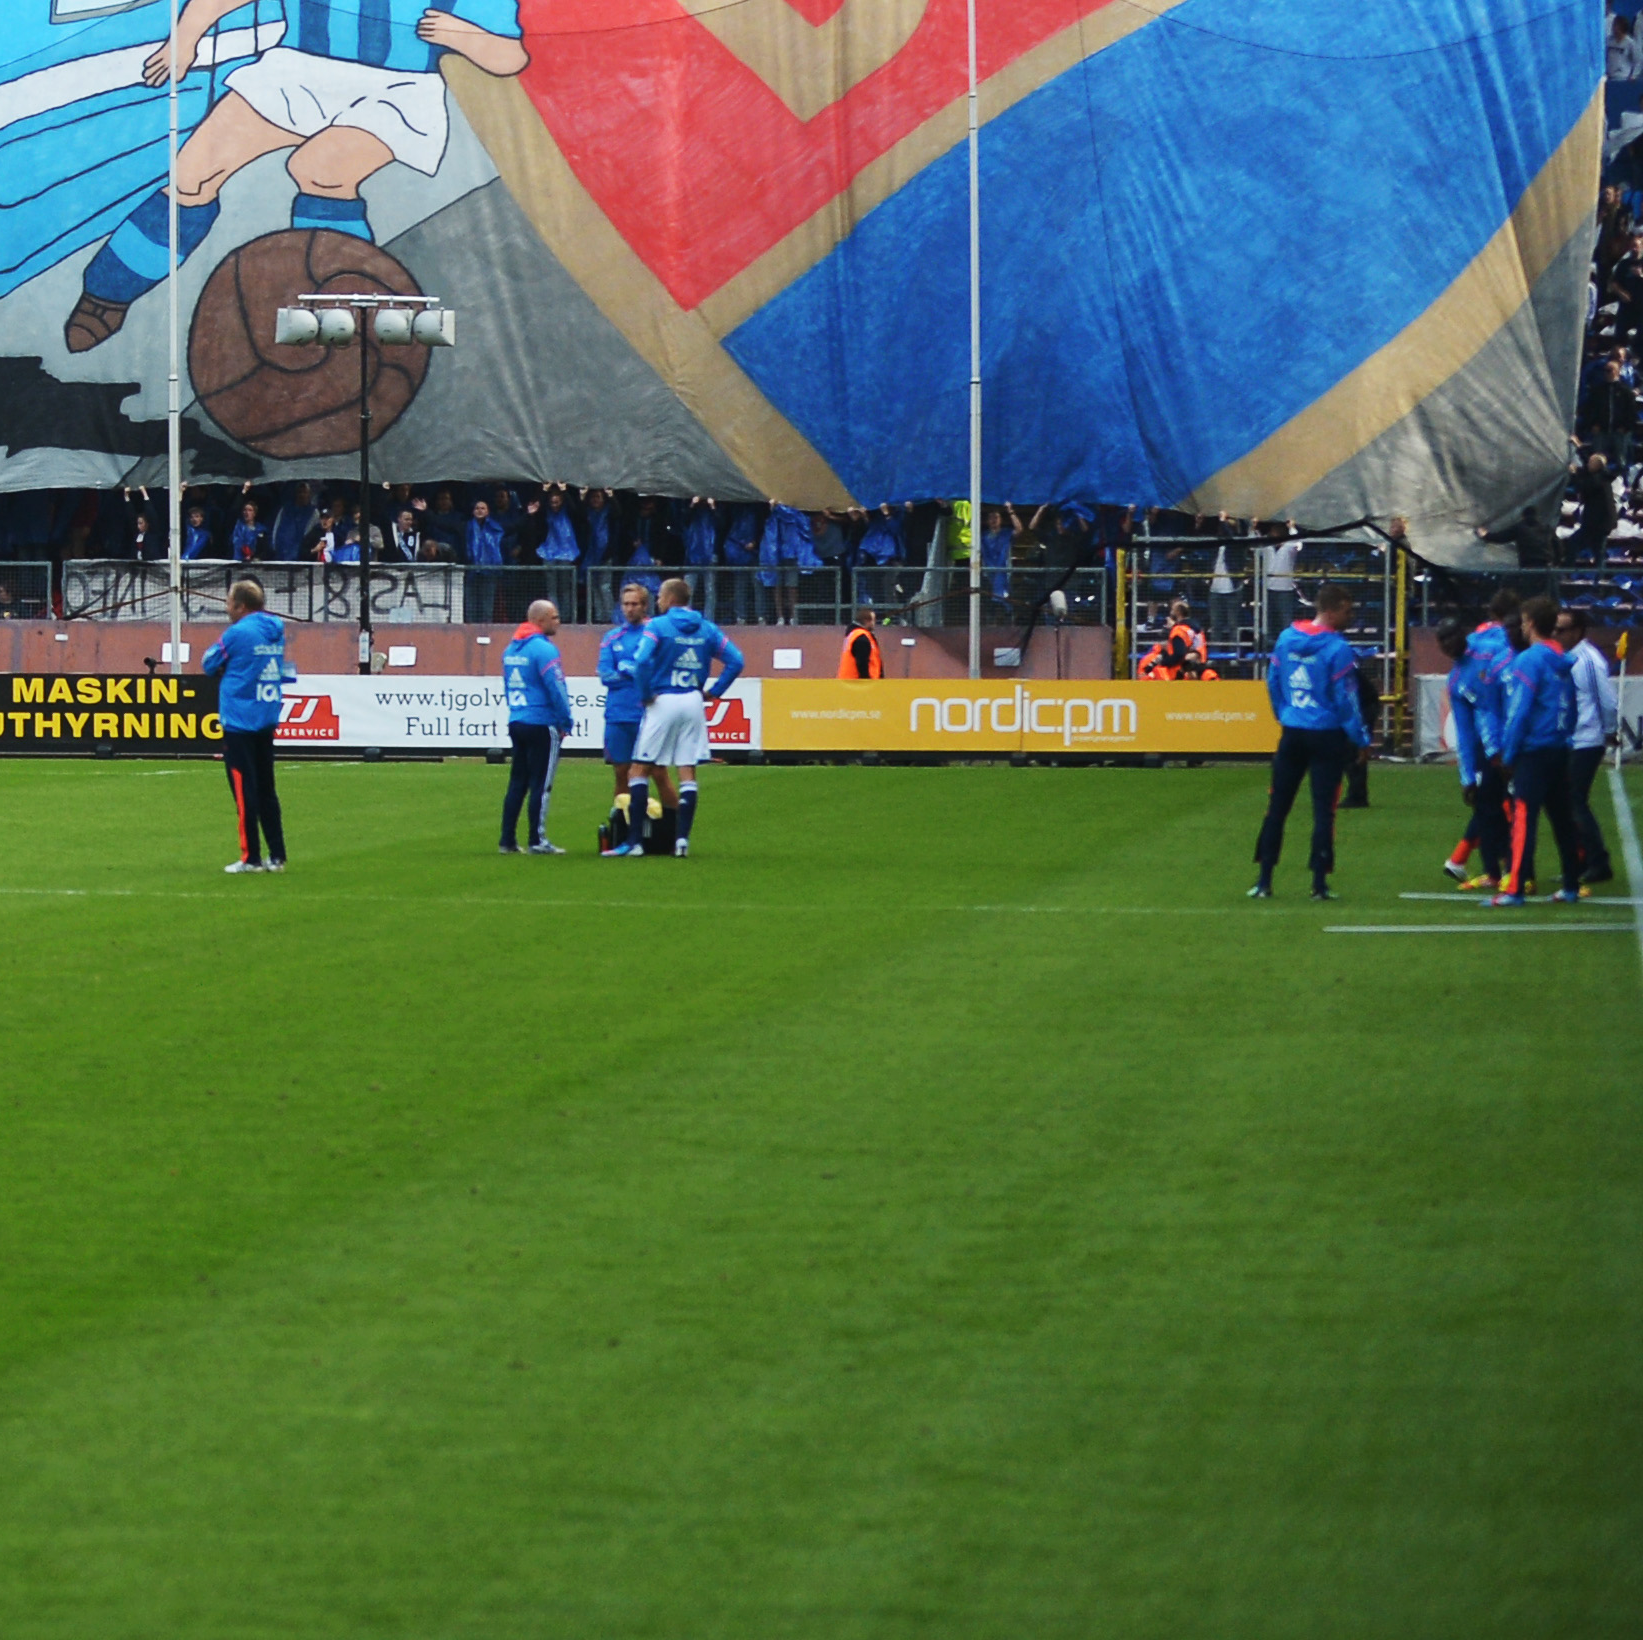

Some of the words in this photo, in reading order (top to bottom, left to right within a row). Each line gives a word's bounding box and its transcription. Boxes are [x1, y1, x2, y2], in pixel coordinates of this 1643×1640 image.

[12, 677, 196, 704] MASKIN-
[375, 687, 607, 711] www.tjgolvce.s
[278, 698, 319, 723] TJ
[275, 728, 334, 737] VSERVICE
[405, 718, 451, 737] Full
[458, 718, 498, 737] fart
